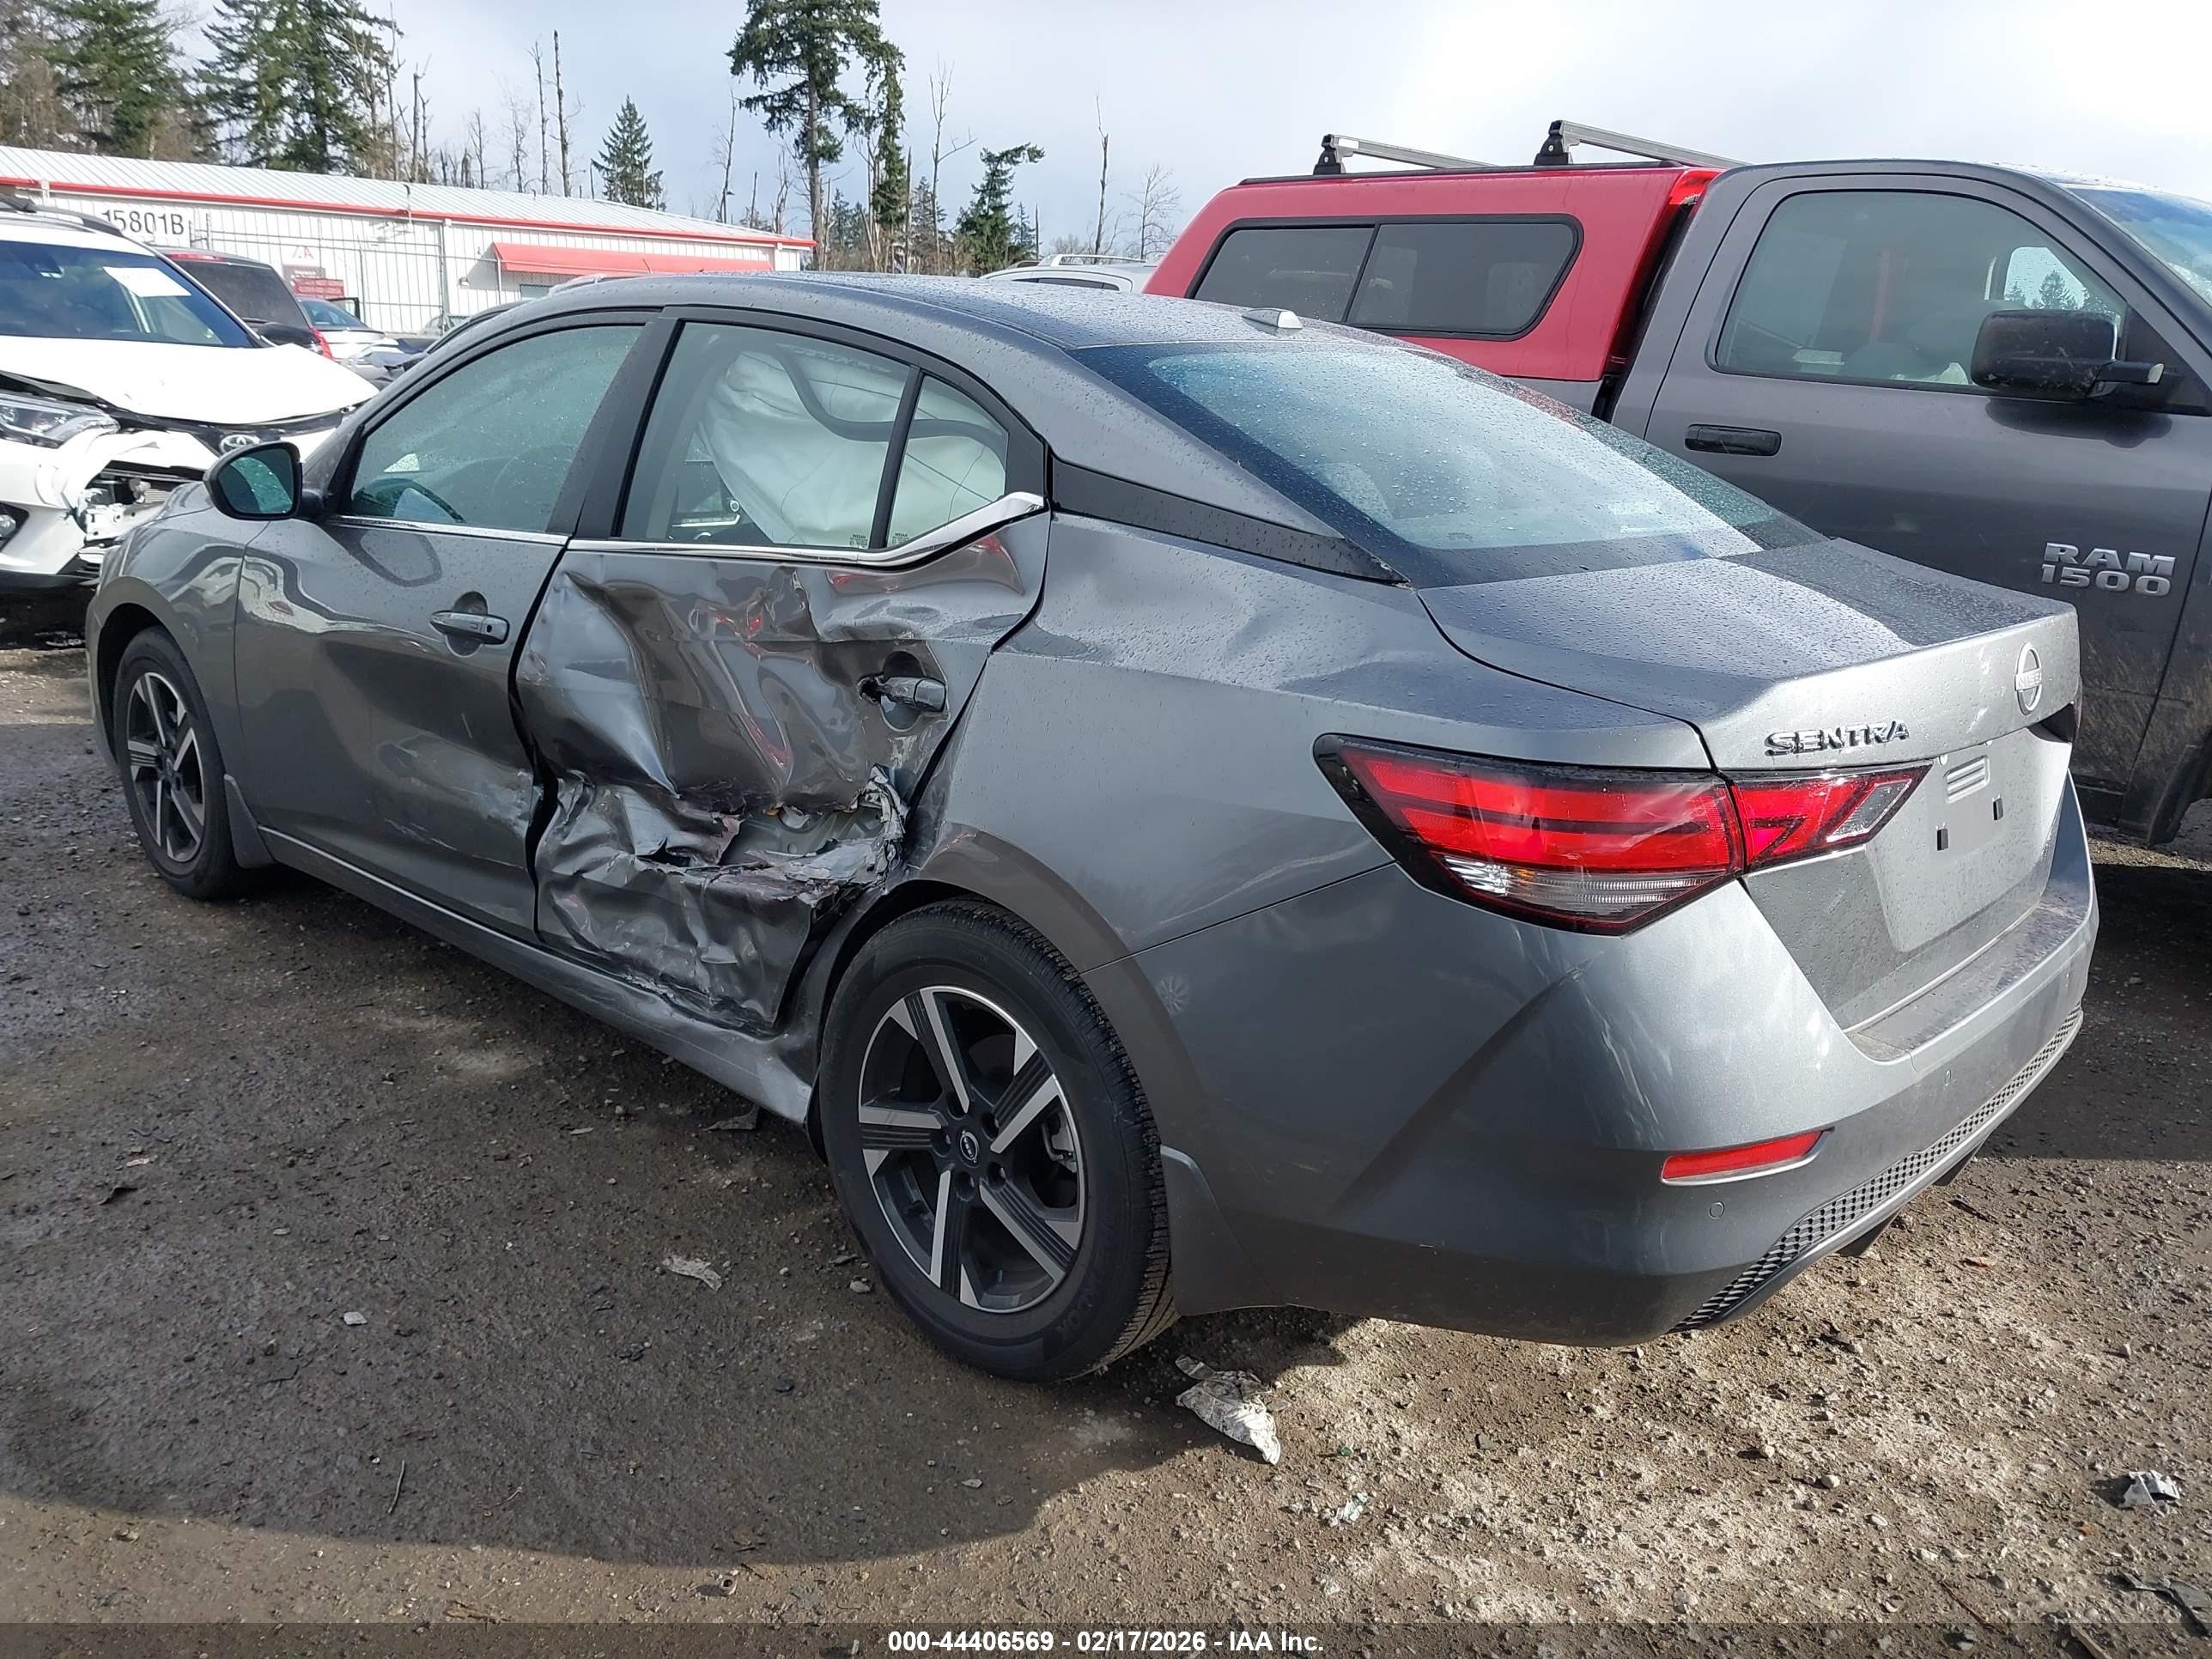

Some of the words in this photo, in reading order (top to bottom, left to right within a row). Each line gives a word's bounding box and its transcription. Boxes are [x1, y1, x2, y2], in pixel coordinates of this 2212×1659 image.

[101, 209, 184, 235] 15801B
[2044, 543, 2176, 576] RAM
[2041, 563, 2171, 597] 1500
[1765, 720, 1910, 757] SENTRA
